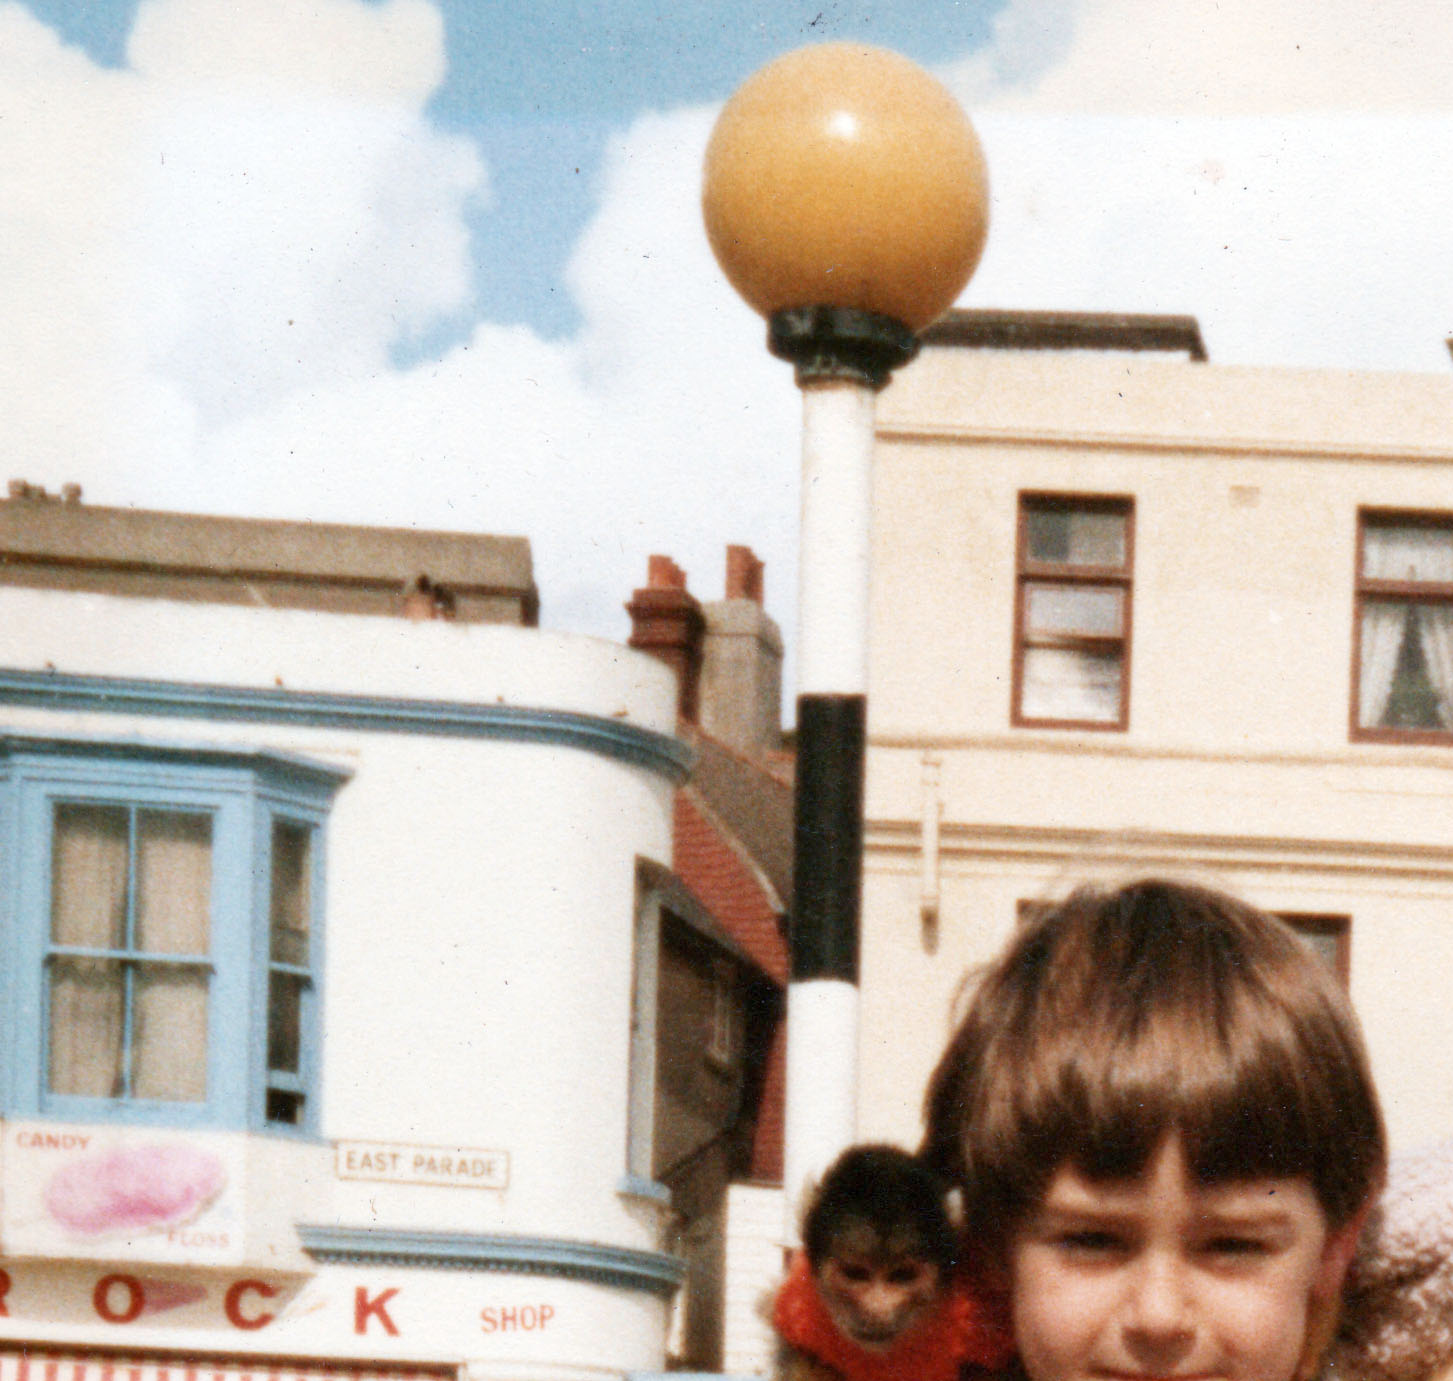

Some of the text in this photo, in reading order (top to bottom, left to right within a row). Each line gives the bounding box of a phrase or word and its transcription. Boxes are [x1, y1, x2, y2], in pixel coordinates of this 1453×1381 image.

[15, 1131, 91, 1151] CANDY
[345, 1151, 497, 1179] EAST PARADE
[0, 1267, 555, 1338] OCK SHOP
